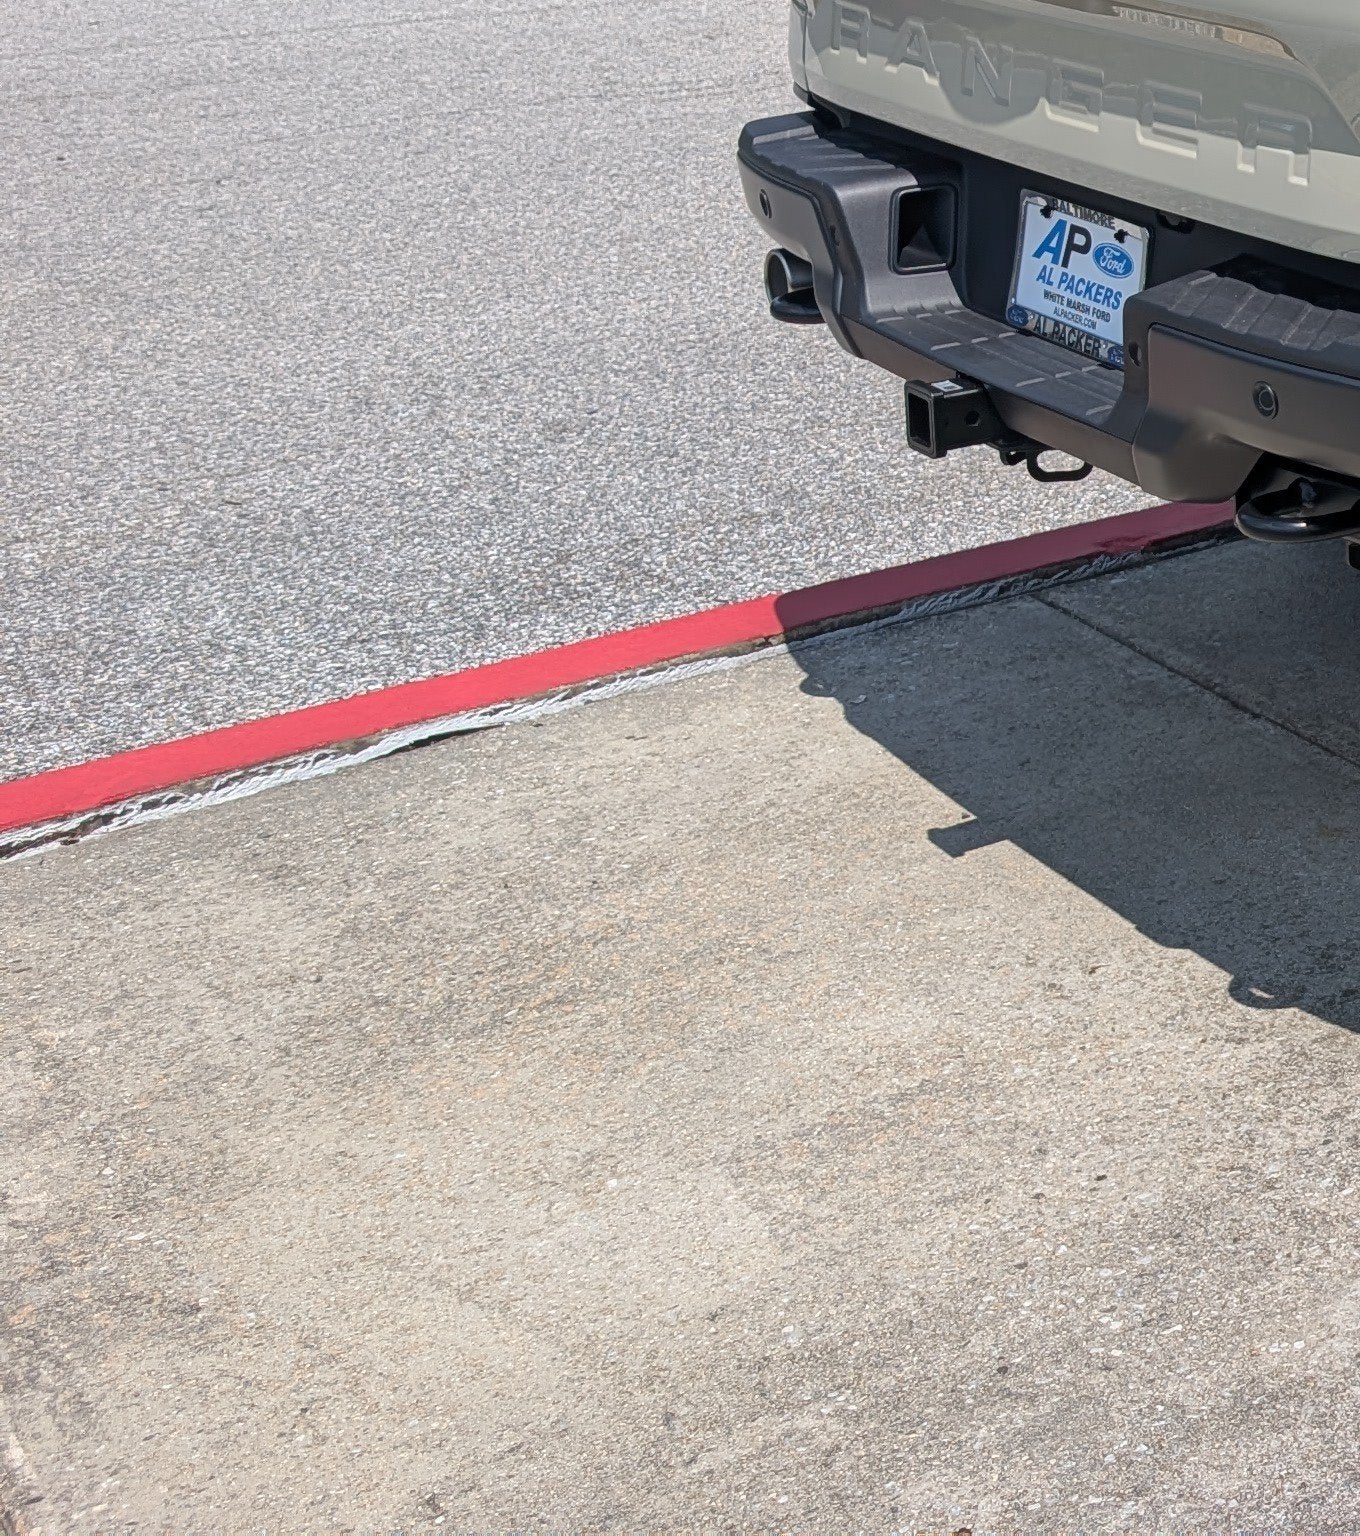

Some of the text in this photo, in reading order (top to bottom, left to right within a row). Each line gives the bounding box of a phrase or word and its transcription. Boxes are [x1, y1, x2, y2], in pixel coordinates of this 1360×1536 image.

[1050, 199, 1116, 231] BALTIMORE
[1032, 218, 1092, 269] AP
[1096, 245, 1129, 276] Ford
[1036, 264, 1123, 310] AL PACKERS
[1043, 288, 1111, 323] WHITE MARSH FORD
[1033, 315, 1050, 337] AL
[1052, 324, 1103, 358] PACKER
